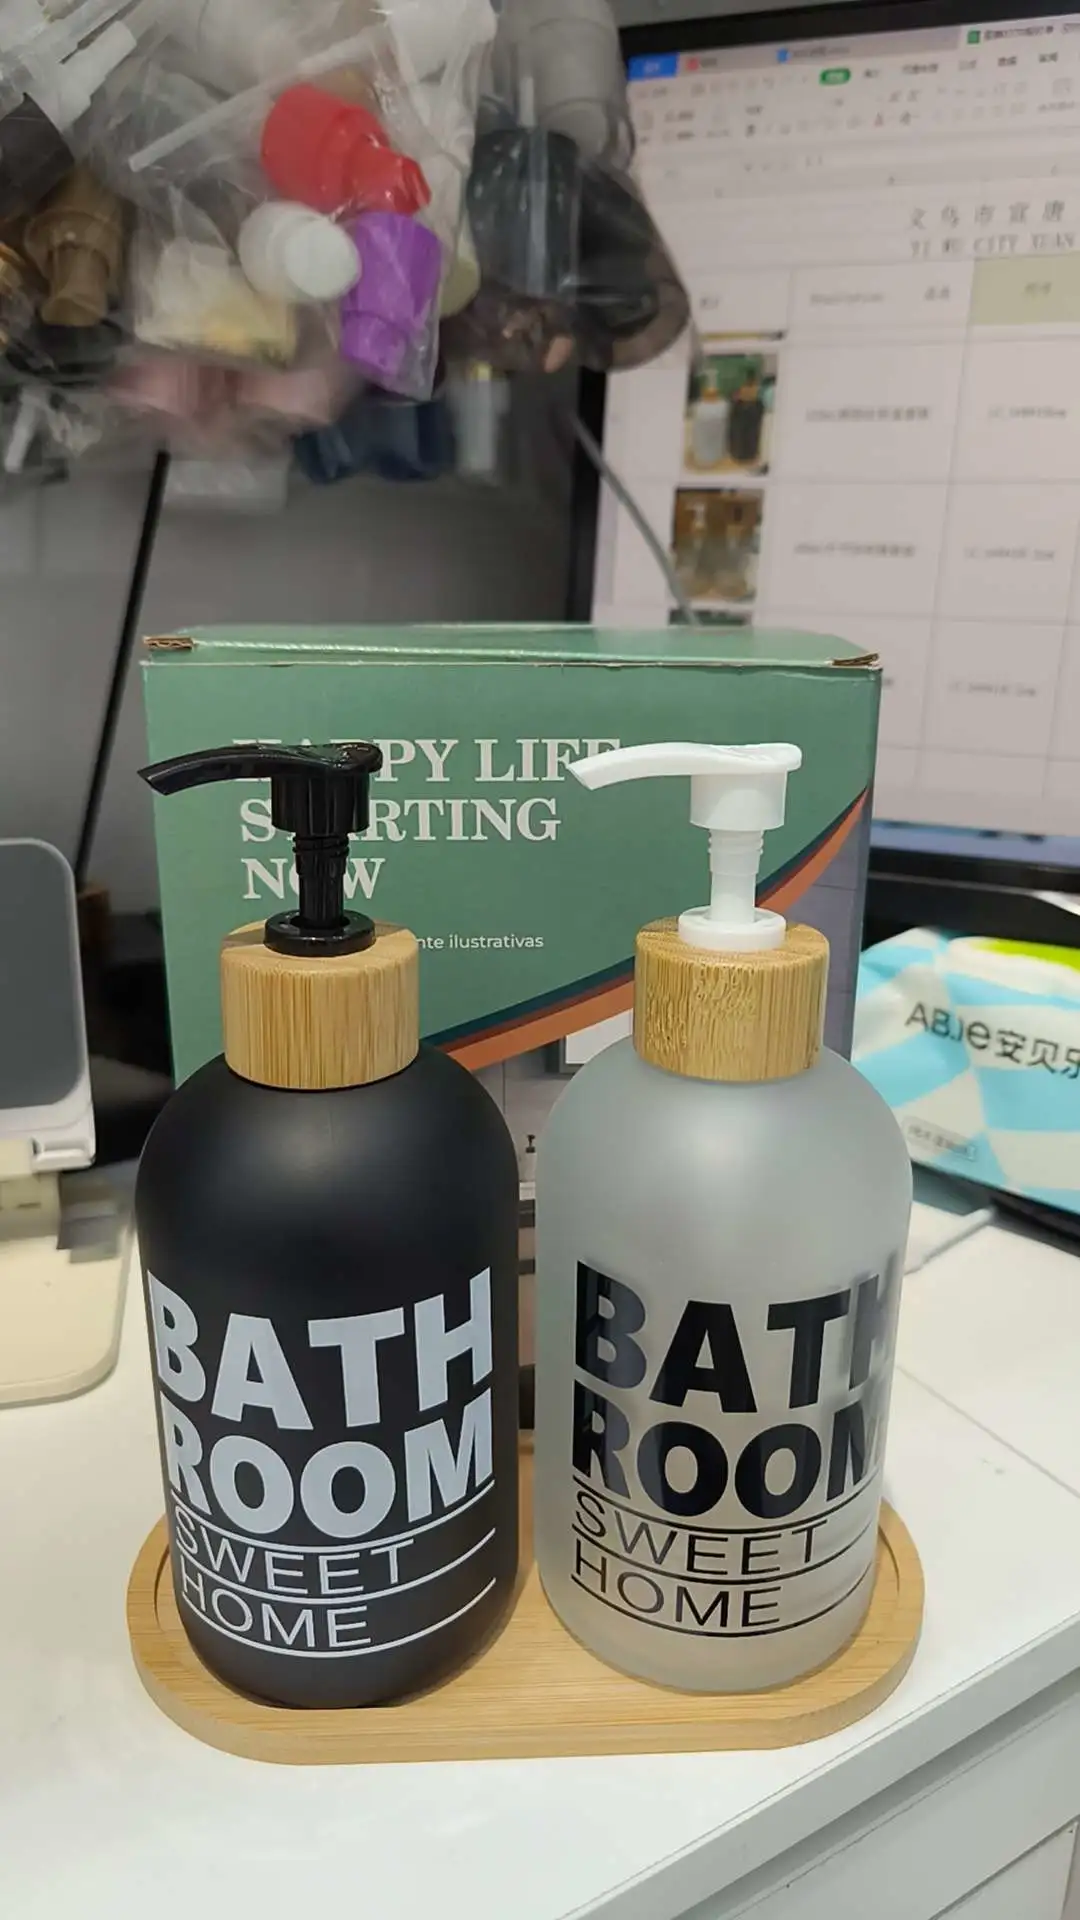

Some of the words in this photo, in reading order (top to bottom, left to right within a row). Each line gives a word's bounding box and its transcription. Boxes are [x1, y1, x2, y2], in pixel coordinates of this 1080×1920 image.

[240, 798, 562, 842] SRTING
[241, 857, 386, 899] NW
[449, 933, 544, 949] ilustrativas
[147, 1266, 493, 1430] BATH
[575, 1254, 896, 1413] BATH
[159, 1387, 493, 1538] ROOM
[175, 1504, 415, 1596] SWEET
[576, 1490, 828, 1576] SWEET
[179, 1556, 371, 1648] HOME
[575, 1539, 781, 1628] HOME
